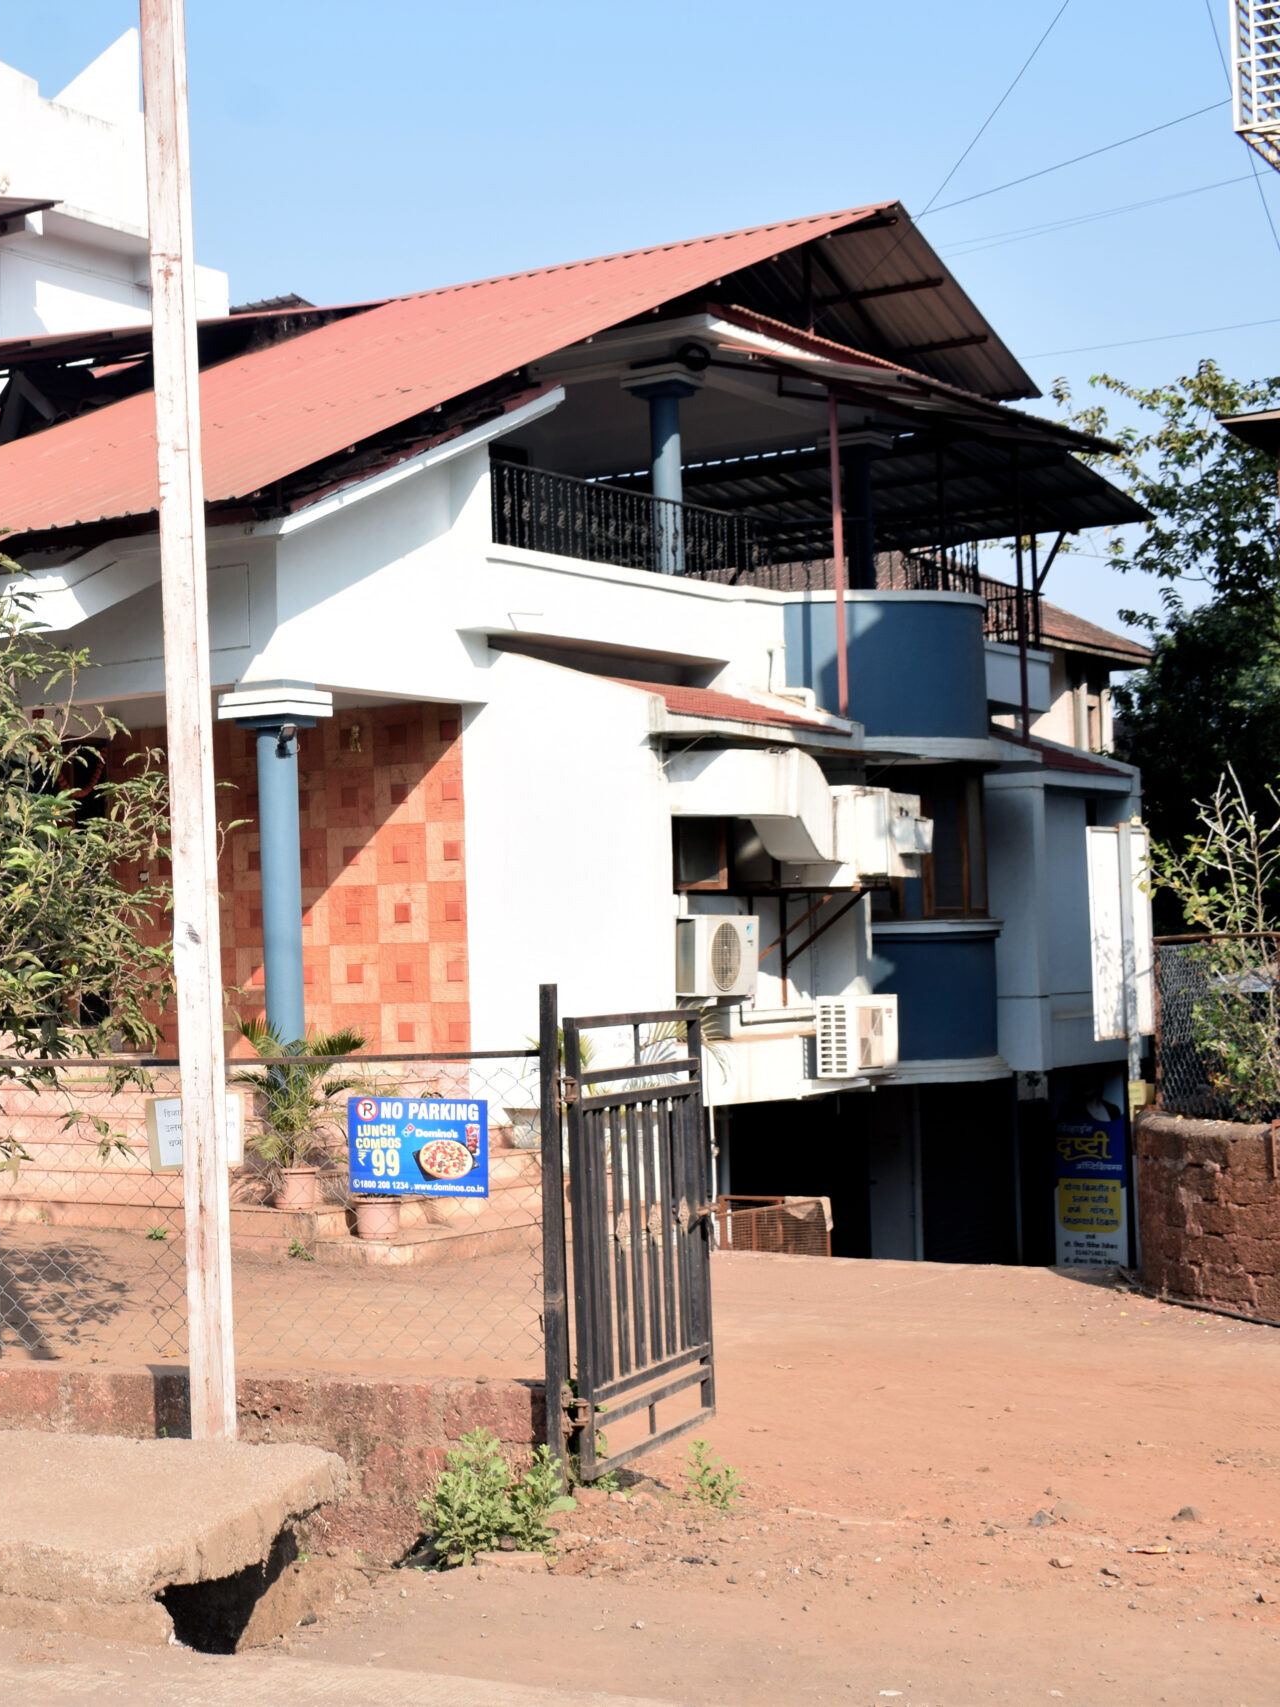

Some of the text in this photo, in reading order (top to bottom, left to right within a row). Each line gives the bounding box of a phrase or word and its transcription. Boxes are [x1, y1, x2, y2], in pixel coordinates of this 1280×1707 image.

[380, 1101, 480, 1122] NO PARKING
[357, 1123, 397, 1138] LUNCH
[415, 1128, 459, 1139] Domino's
[355, 1136, 402, 1150] COMBOS
[1055, 1130, 1112, 1161] दृष्टी
[360, 1179, 485, 1194] 1800 208 1234 www.dominos.co.in
